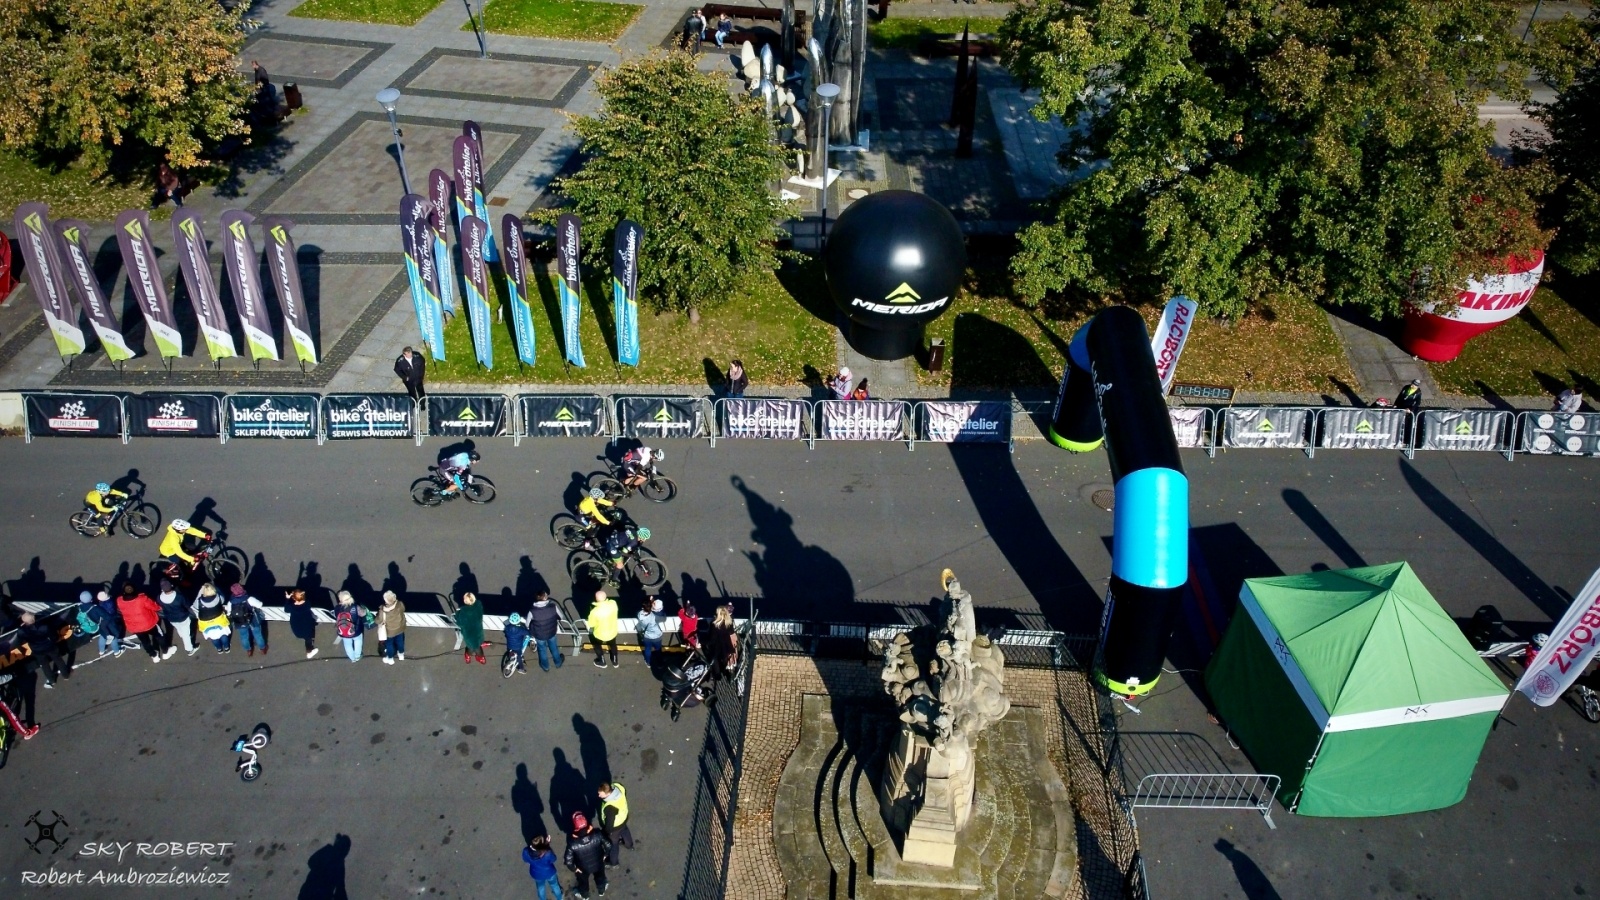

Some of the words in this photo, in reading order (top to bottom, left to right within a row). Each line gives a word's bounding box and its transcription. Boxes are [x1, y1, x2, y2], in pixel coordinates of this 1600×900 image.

[462, 142, 472, 178] atelier
[463, 179, 473, 202] bike
[471, 222, 480, 258] atelier
[564, 220, 576, 256] atelier
[30, 232, 61, 310] MERIDA
[69, 244, 105, 318] MERIDA
[130, 239, 161, 313] MERIDA
[233, 239, 256, 317] MERIDA
[275, 243, 298, 319] MERIDA
[422, 258, 432, 282] bike
[473, 258, 482, 284] bike
[566, 258, 577, 282] bike
[851, 296, 948, 315] MERIDA
[517, 307, 532, 359] ROWEROWE
[234, 408, 263, 422] bike
[266, 408, 310, 422] atelier
[331, 409, 360, 423] bike
[364, 409, 408, 423] atelier
[440, 420, 495, 428] MERIDA
[538, 420, 593, 428] MERIDA
[636, 421, 691, 429] MERIDA
[729, 414, 756, 427] bike
[758, 414, 798, 428] atelier
[828, 416, 855, 429] bike
[858, 417, 898, 430] atelier
[960, 417, 999, 430] atelier
[234, 429, 259, 437] SKLEP
[260, 429, 311, 437] ROWEROWY
[332, 430, 361, 438] SERWIS
[361, 430, 408, 438] ROWEROWY
